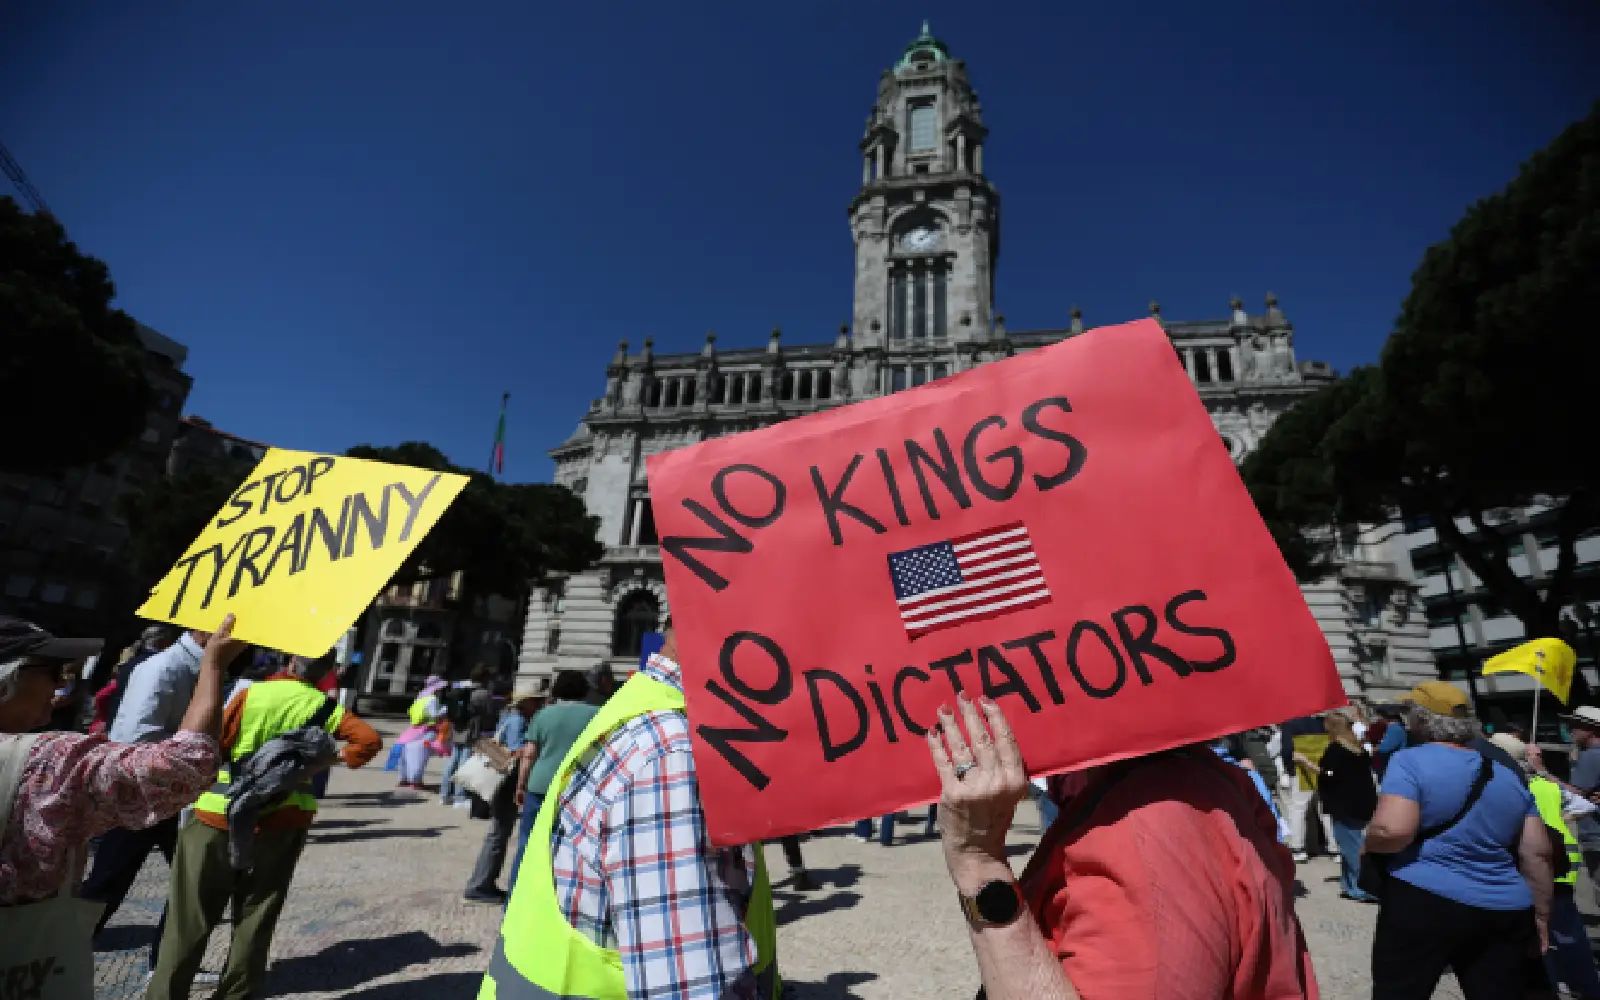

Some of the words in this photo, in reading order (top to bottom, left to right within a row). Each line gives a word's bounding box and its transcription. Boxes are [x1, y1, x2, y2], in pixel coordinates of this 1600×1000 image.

[169, 474, 442, 619] TYRANNY
[217, 456, 335, 529] STOP
[662, 463, 786, 592] NO
[810, 396, 1088, 545] KINGS
[696, 631, 792, 792] NO
